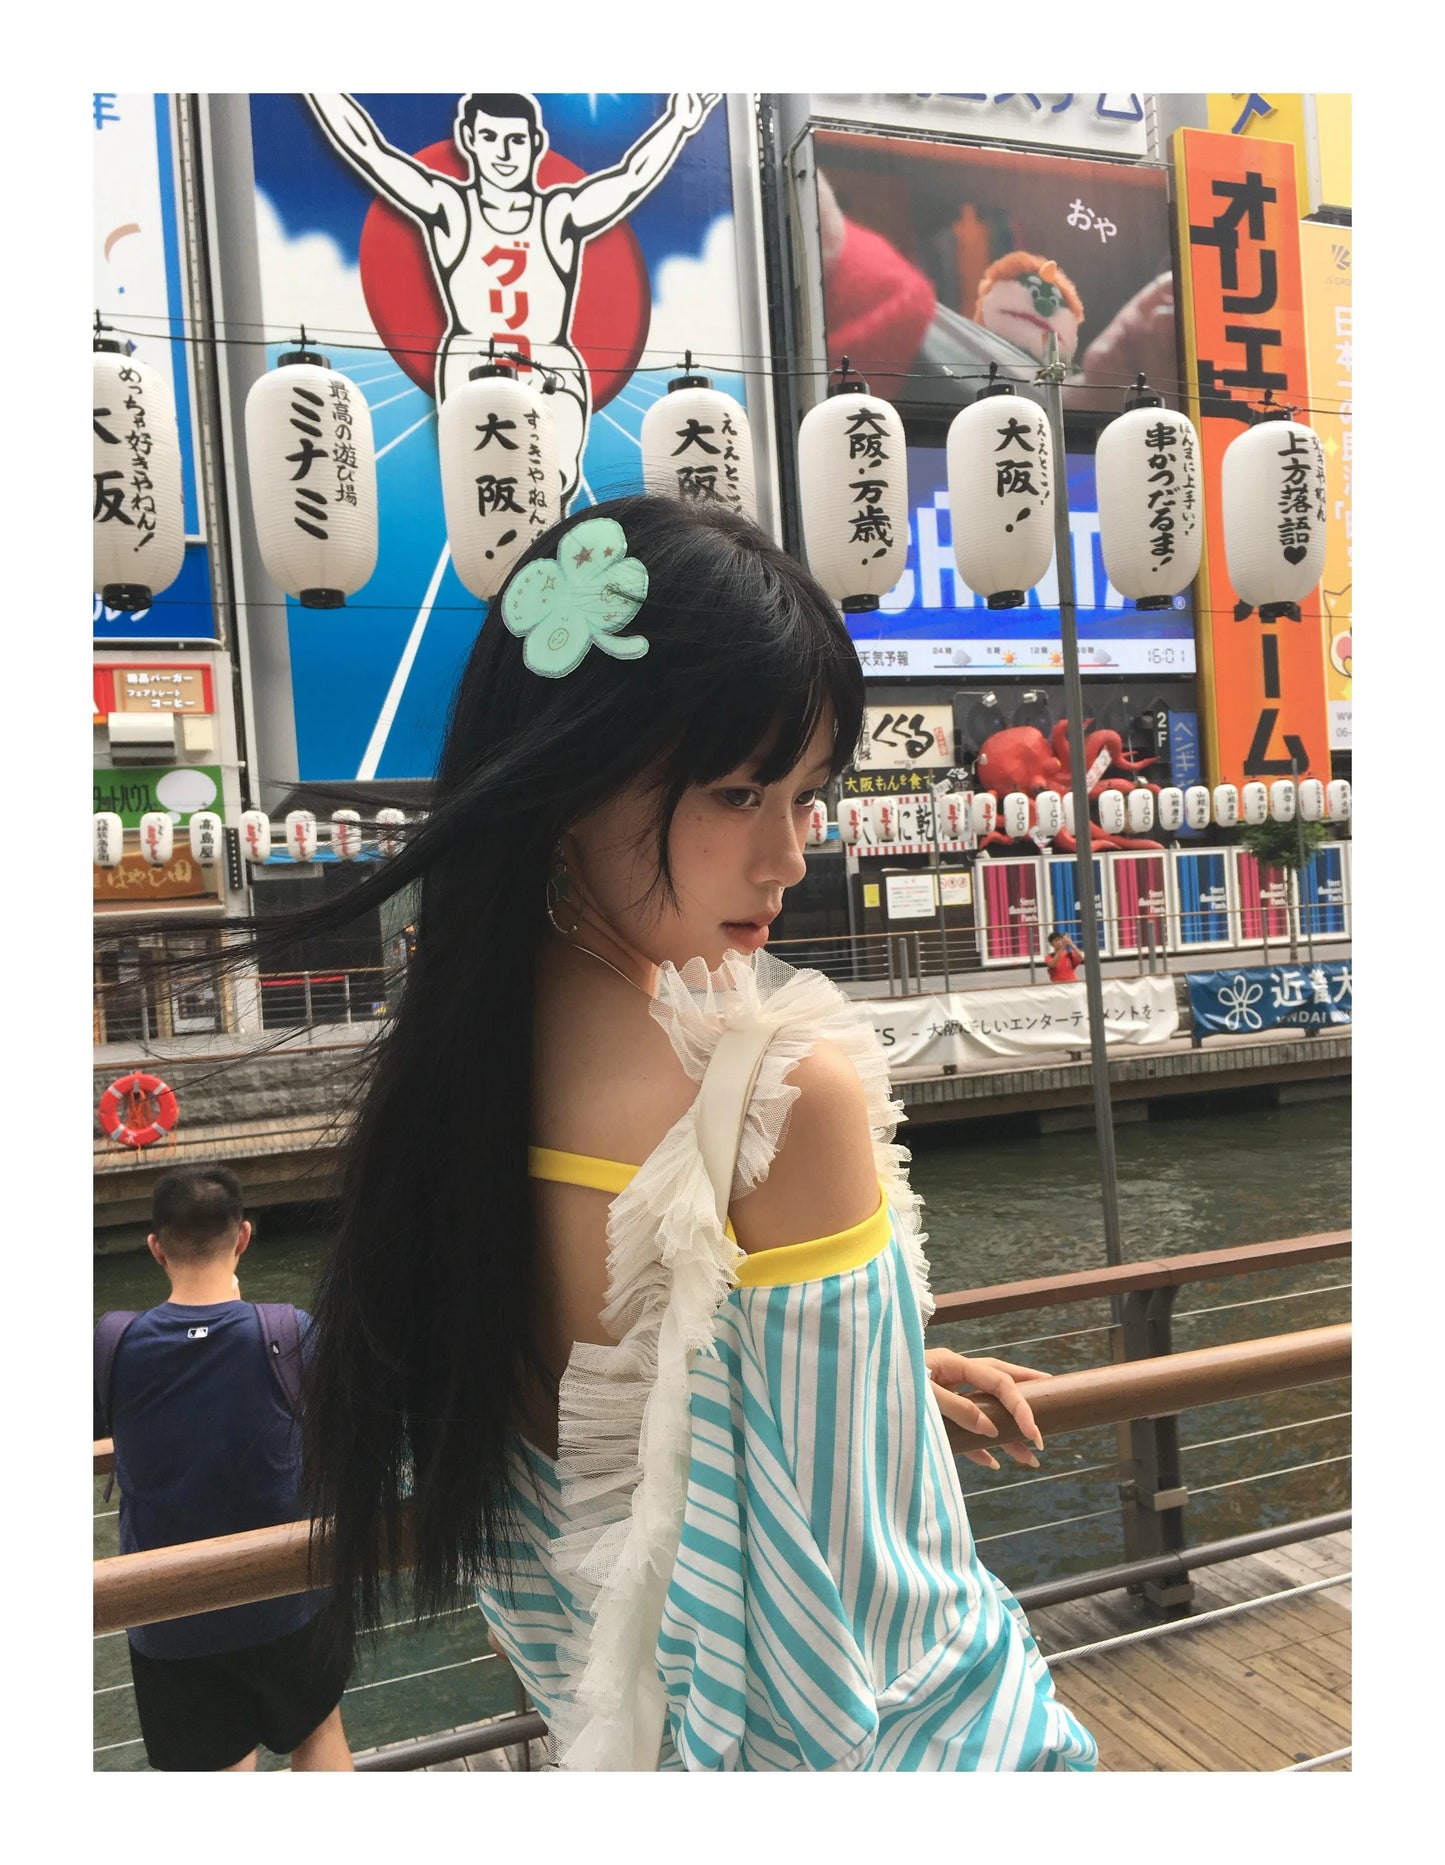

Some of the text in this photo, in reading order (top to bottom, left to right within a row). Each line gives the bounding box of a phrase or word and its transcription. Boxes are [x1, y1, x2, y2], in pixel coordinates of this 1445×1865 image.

[1066, 198, 1118, 243] おや
[480, 241, 532, 373] グリコ
[285, 386, 329, 540] ミナミ
[327, 379, 359, 507] 最高の遊び場
[473, 412, 527, 560] 大阪!
[843, 407, 894, 566] 大阪!万歳!
[993, 416, 1040, 533] 大阪!
[1144, 421, 1182, 572] 串かつだるま!
[1179, 422, 1197, 536] ほんまに上手い!
[1277, 430, 1313, 546] 上方落語
[151, 699, 195, 708] コーヒー
[858, 650, 909, 667] 天気予報
[1147, 648, 1186, 664] 16:01
[872, 713, 935, 759] くくる
[1156, 711, 1168, 748] 2F
[199, 818, 214, 859] 高島屋
